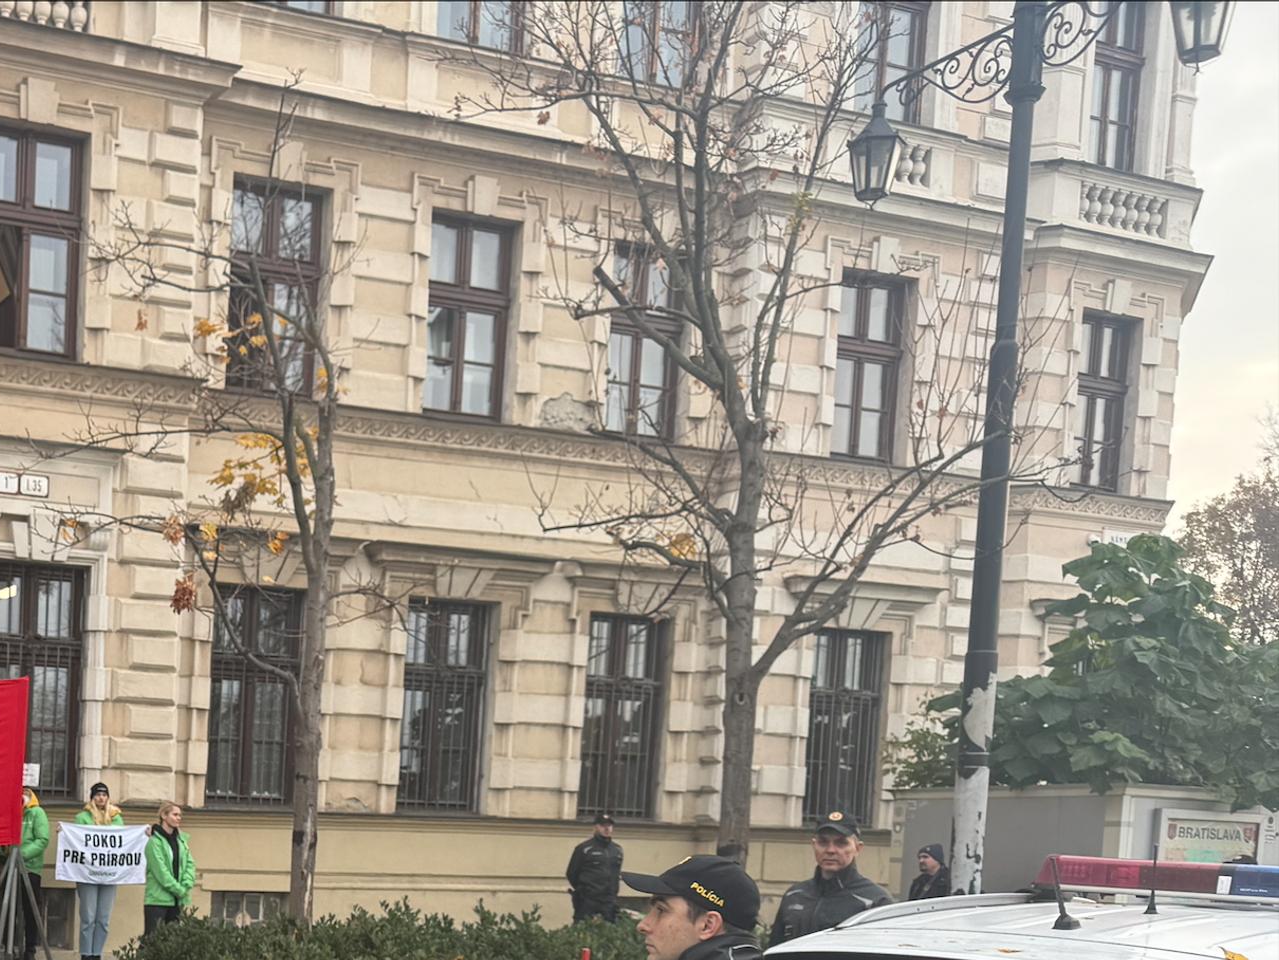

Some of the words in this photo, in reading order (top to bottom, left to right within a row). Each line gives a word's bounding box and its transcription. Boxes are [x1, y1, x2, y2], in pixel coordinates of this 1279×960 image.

[84, 833, 123, 848] POKOJ
[1177, 826, 1242, 841] BRATISLAVA
[63, 849, 86, 864] PRE
[690, 881, 725, 908] POLÍCIA
